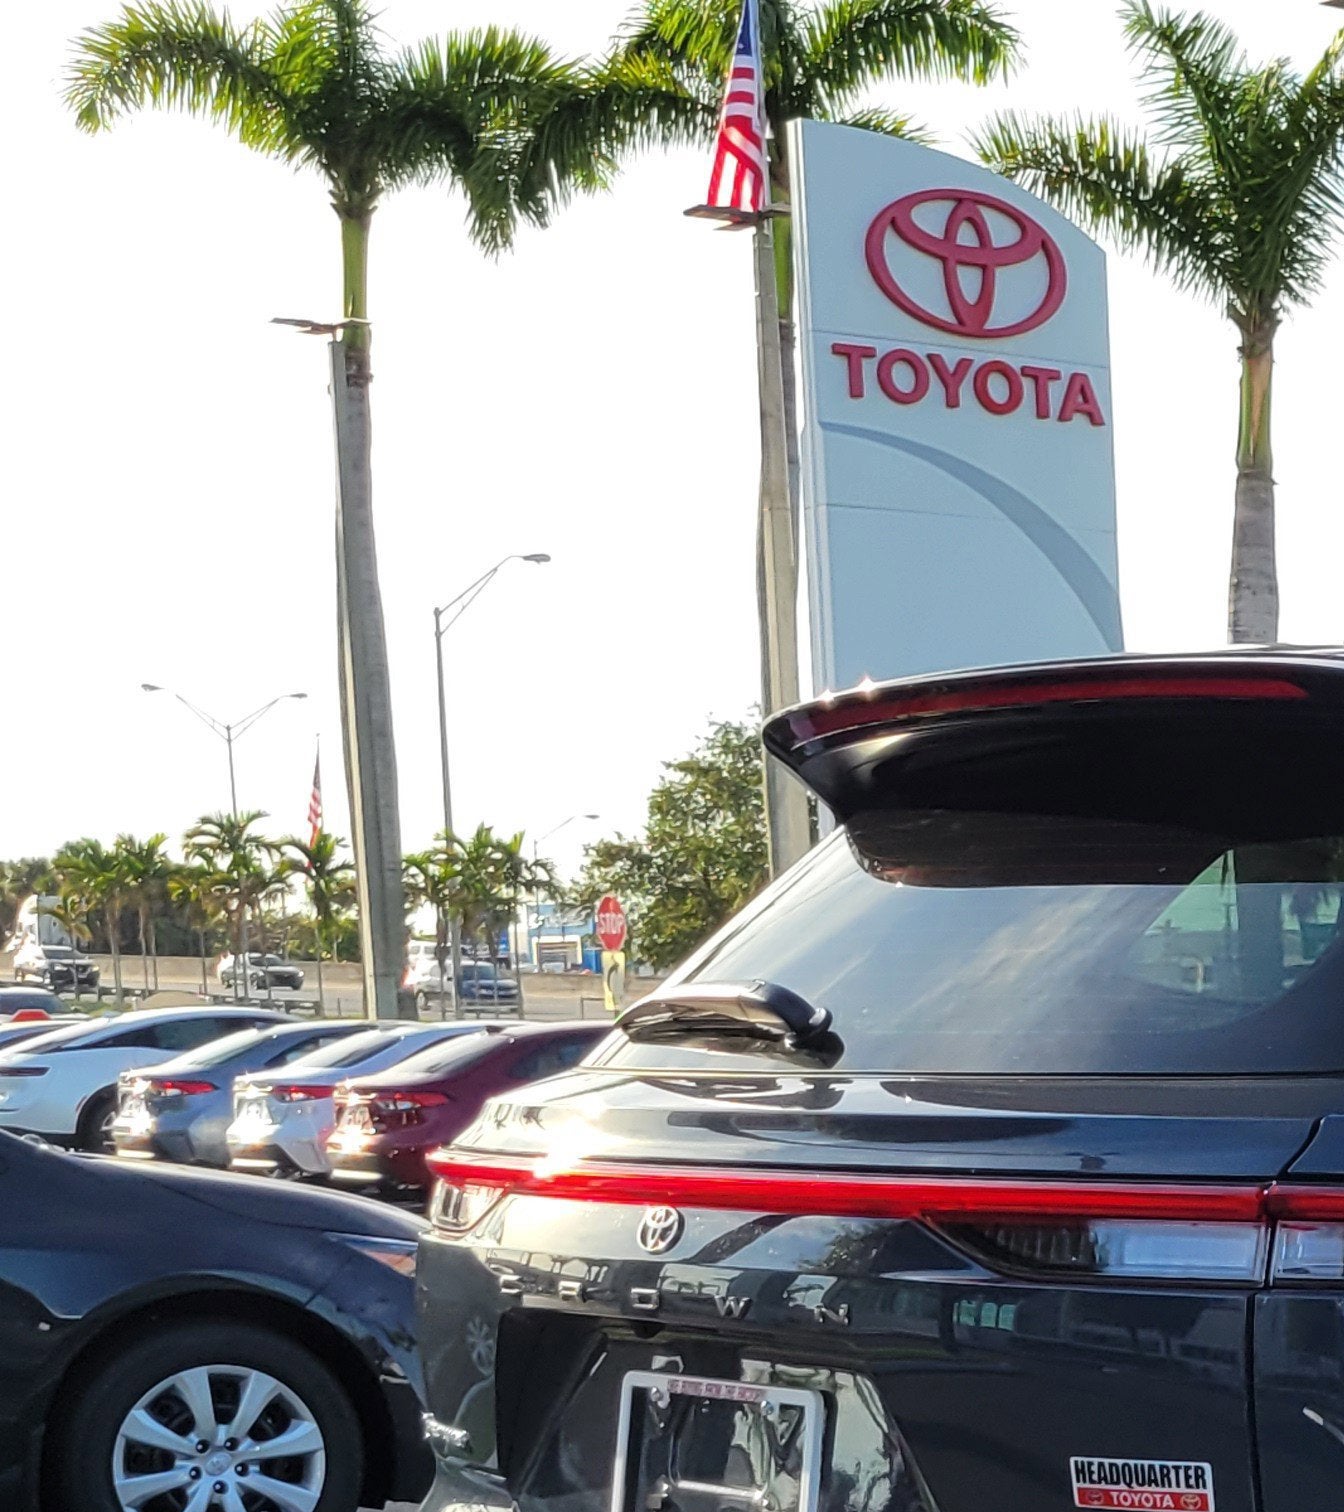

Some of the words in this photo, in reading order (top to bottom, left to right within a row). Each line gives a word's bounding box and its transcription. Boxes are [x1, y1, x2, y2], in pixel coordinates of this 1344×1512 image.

[831, 342, 1106, 427] TOYOTA
[599, 912, 625, 935] STOP
[1073, 1459, 1208, 1490] HEADQUARTER
[1109, 1491, 1175, 1509] TOYOTA
